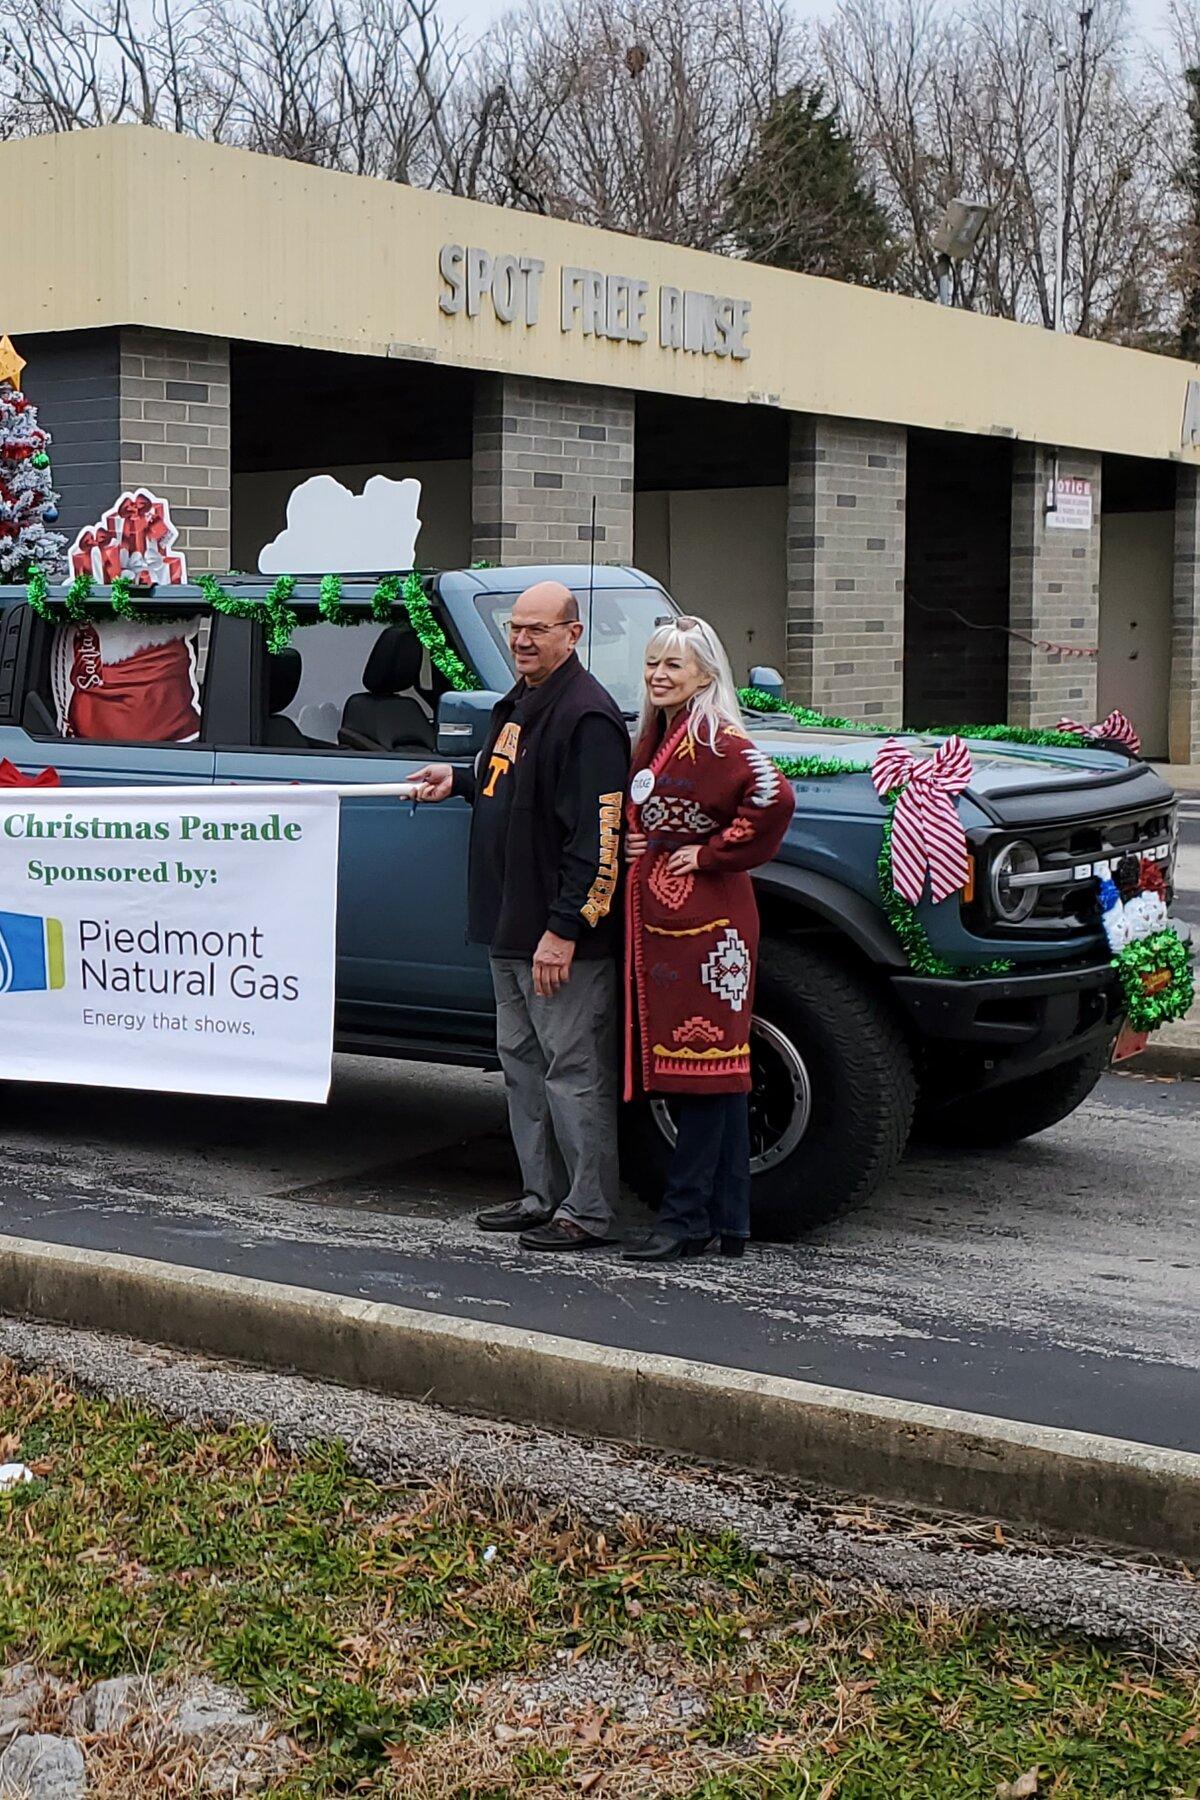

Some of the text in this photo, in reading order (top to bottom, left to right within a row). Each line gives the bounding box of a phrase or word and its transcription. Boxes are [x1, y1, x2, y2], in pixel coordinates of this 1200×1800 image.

[438, 243, 752, 361] SPOT FREE RINSE
[483, 755, 510, 797] T
[4, 813, 170, 841] Christmas
[178, 814, 302, 842] Parade
[27, 860, 218, 889] Sponsored by:
[79, 919, 264, 958] Piedmont
[81, 958, 299, 1001] Natural Gas
[83, 1008, 256, 1036] Energy that shows.
